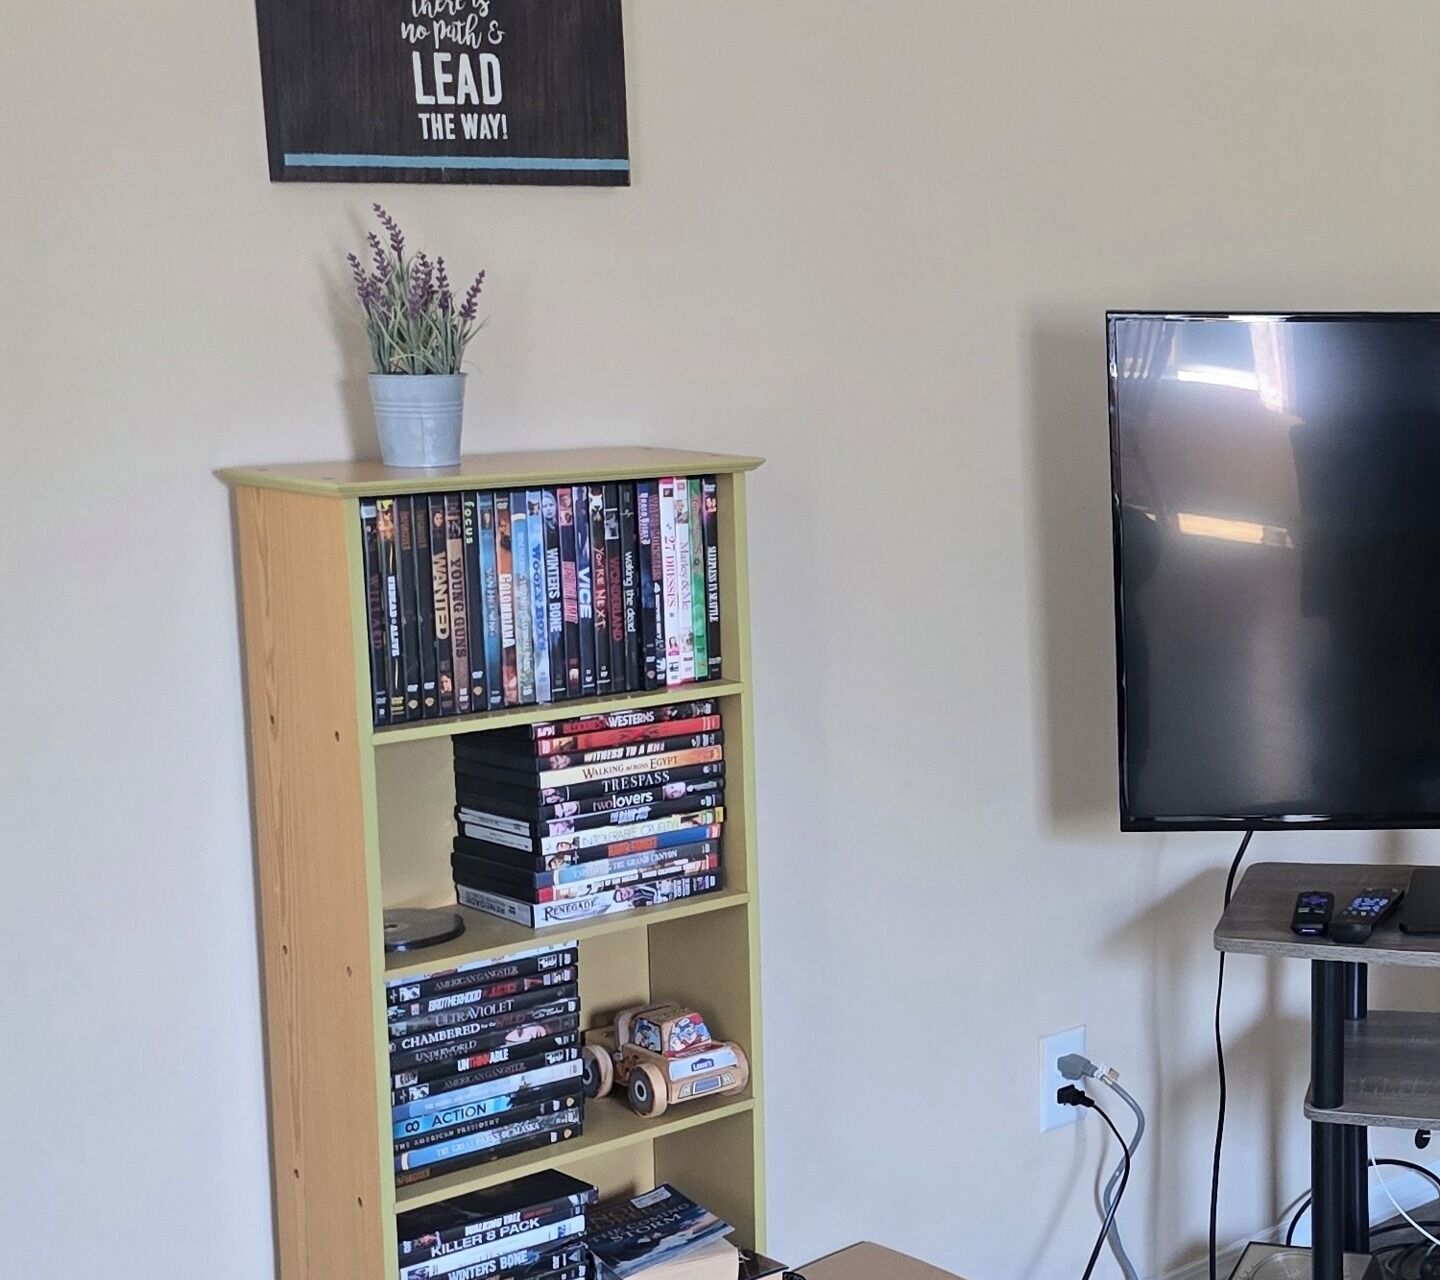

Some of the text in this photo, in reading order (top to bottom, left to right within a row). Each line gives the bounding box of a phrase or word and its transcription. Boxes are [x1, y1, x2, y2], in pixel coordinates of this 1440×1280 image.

[400, 19, 429, 43] no
[431, 12, 482, 50] path
[412, 50, 504, 107] LEAD
[417, 111, 510, 141] THE WAY!
[464, 501, 475, 545] focus
[663, 535, 676, 608] 27 DRESSES
[433, 551, 450, 641] WANTED
[579, 566, 592, 619] VICE
[609, 555, 623, 642] WONDERLAND
[623, 551, 637, 632] waking the dead
[451, 558, 467, 659] YOUNG GUNS
[499, 572, 515, 649] COLOMBIANA
[549, 602, 563, 633] BONE
[607, 710, 655, 729] WESTERNS
[582, 764, 624, 780] WALKING
[650, 755, 679, 769] EGYPT
[583, 746, 624, 762] WITNESS
[601, 770, 671, 793] TRESPASS
[650, 848, 678, 865] CANYON
[543, 900, 596, 922] RENEGADE
[435, 999, 515, 1028] ULTRAVIOLET
[401, 1022, 481, 1050] CHAMBERED
[431, 1102, 487, 1128] ACTION
[511, 1120, 541, 1136] ALASKA
[394, 1140, 411, 1152] THE
[414, 1130, 454, 1147] AMERICAN
[503, 1211, 521, 1228] TALL
[610, 1213, 683, 1243] STORM
[625, 1202, 690, 1231] COMING
[430, 1217, 541, 1258] KILLER 8 PACK
[499, 1250, 530, 1270] BONE
